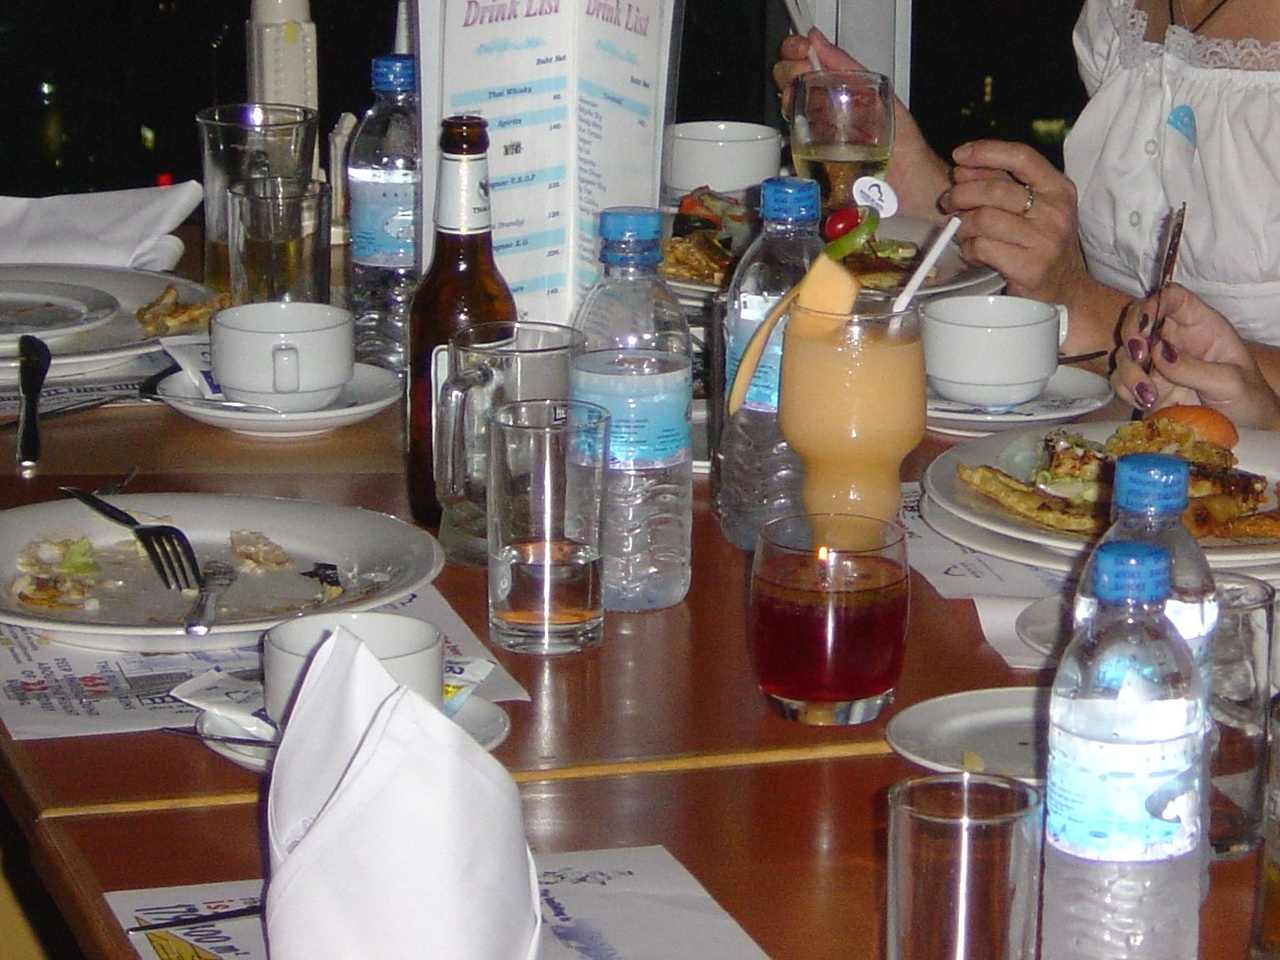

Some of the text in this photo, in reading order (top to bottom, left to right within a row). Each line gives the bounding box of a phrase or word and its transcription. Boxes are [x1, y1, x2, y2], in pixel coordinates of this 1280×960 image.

[625, 3, 649, 37] List
[488, 86, 532, 99] Thai Whisky
[498, 119, 522, 128] Spirits
